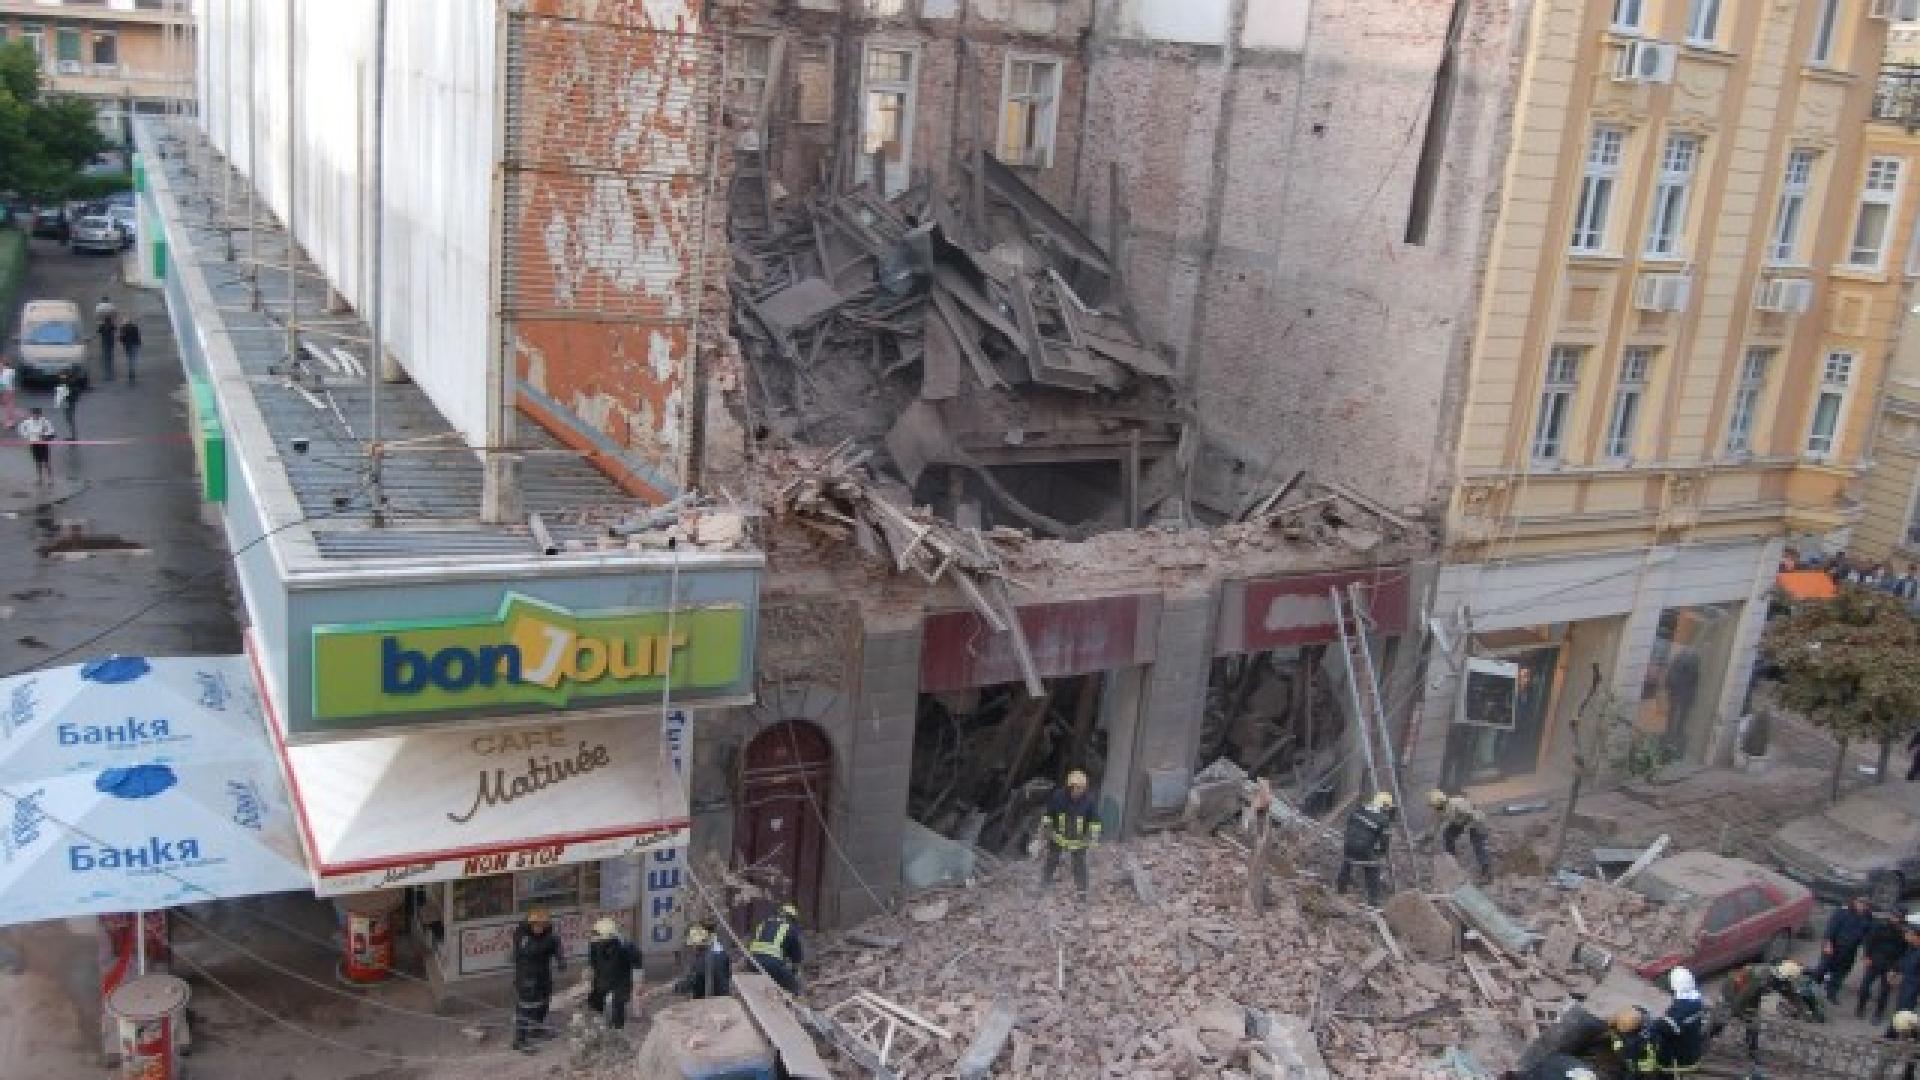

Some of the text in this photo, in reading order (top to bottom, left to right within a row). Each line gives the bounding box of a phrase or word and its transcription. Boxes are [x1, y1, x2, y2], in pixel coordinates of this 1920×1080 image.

[471, 724, 567, 755] CAFE
[463, 855, 509, 877] NON
[515, 844, 565, 871] STOP
